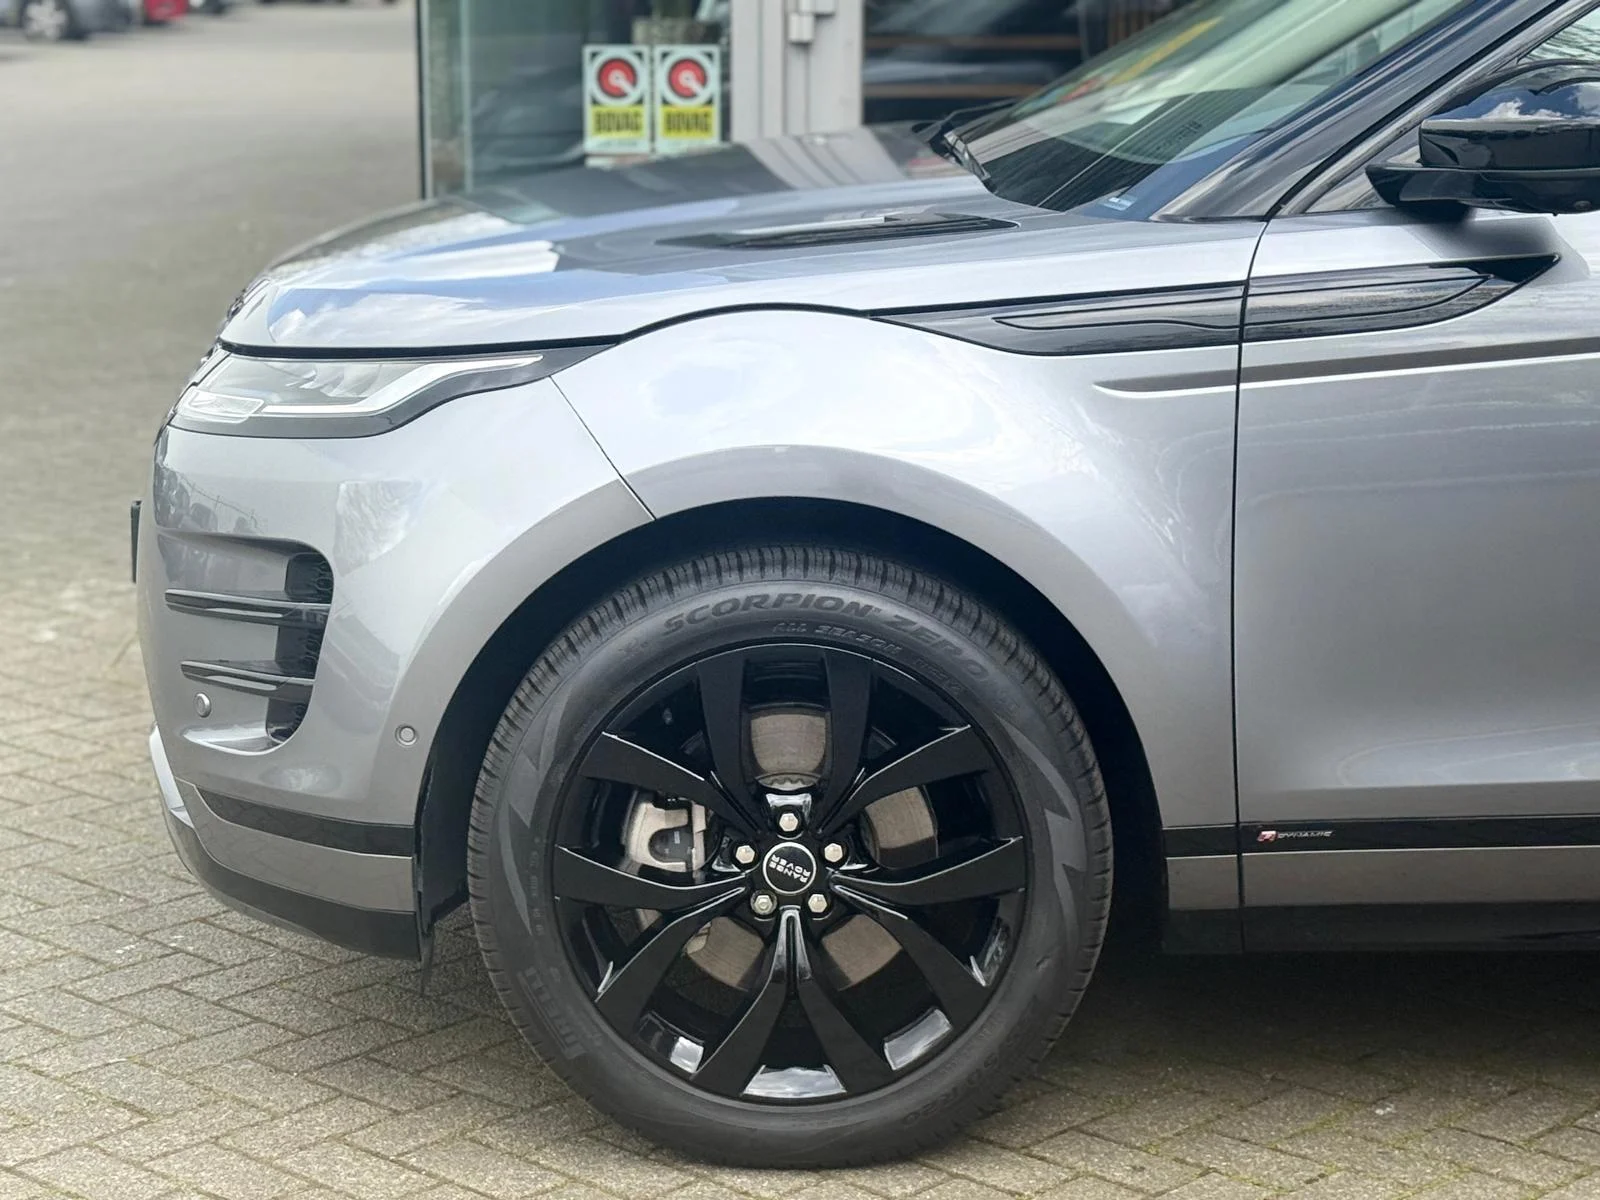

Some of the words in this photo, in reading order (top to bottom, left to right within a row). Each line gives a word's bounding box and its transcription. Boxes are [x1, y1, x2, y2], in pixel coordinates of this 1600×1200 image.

[663, 592, 874, 636] SCORPION
[881, 613, 990, 683] ZERO
[769, 861, 808, 883] RANGE
[771, 854, 811, 877] ROVER
